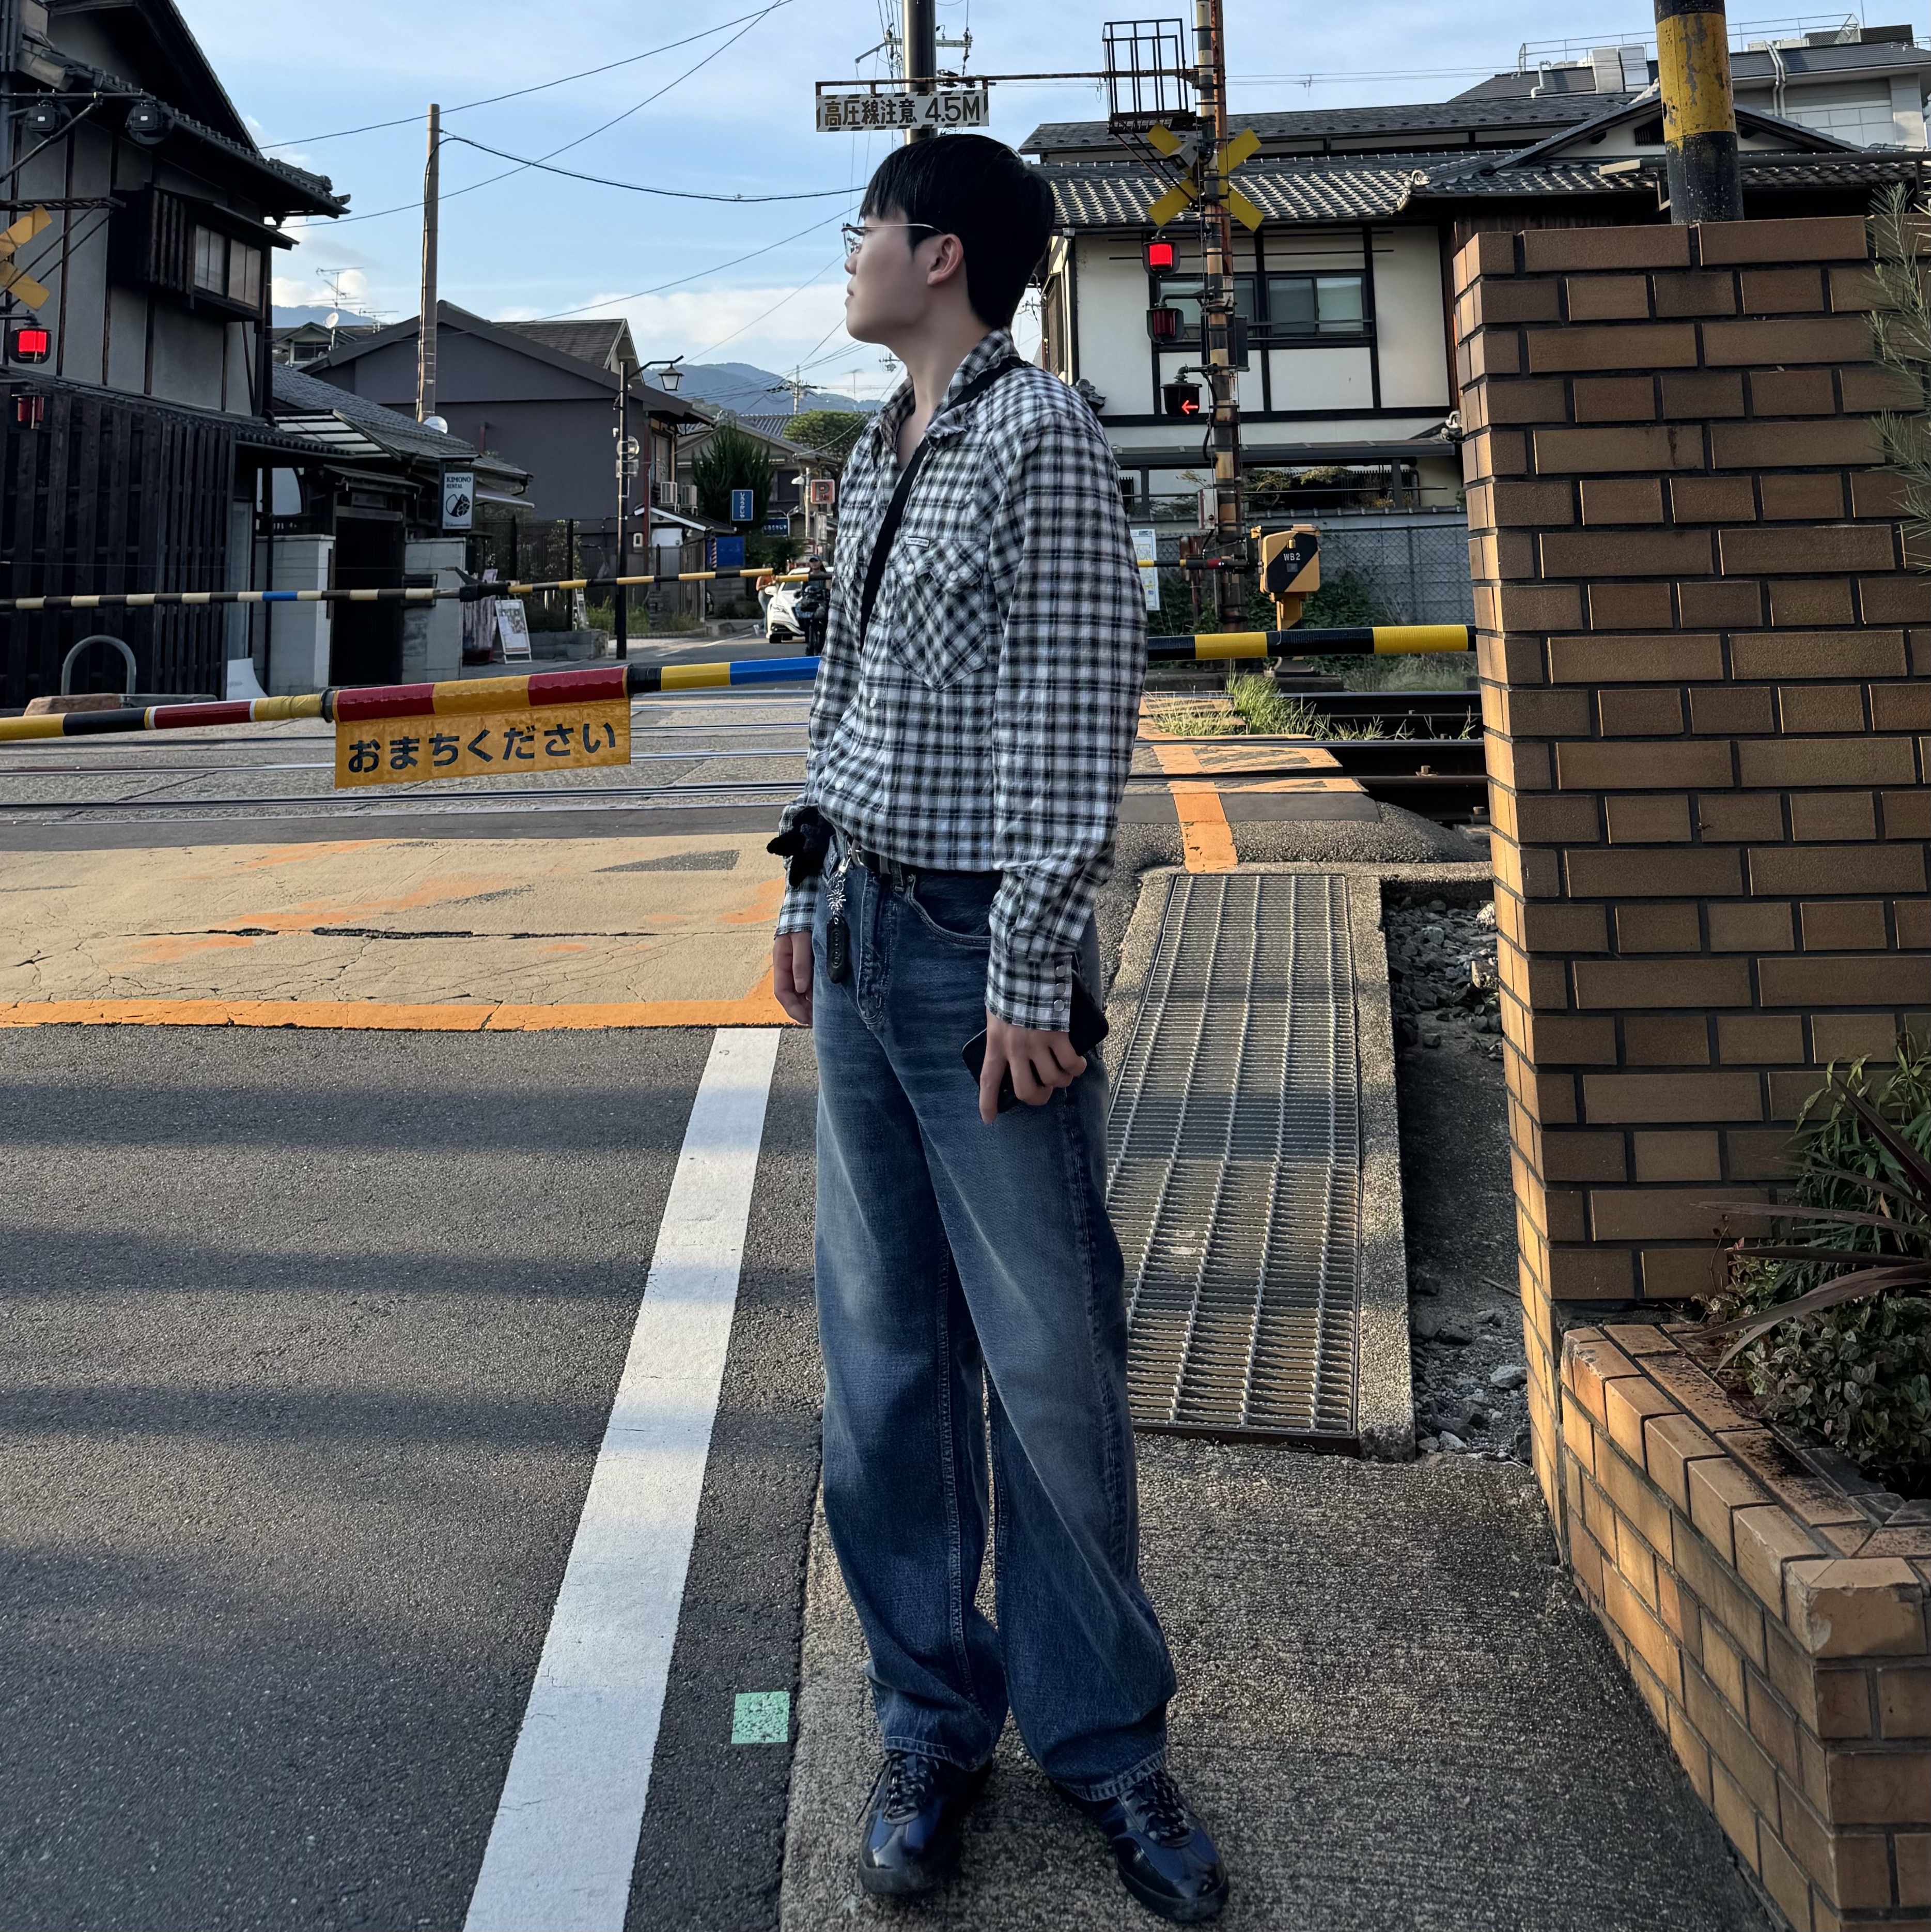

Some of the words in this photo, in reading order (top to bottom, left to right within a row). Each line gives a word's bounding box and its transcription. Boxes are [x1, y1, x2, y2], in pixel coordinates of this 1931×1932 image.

[824, 98, 917, 126] 高圧線注意
[925, 96, 980, 122] 4.5M
[815, 481, 830, 501] P
[1283, 552, 1301, 561] WB2
[348, 723, 616, 773] おまちください
